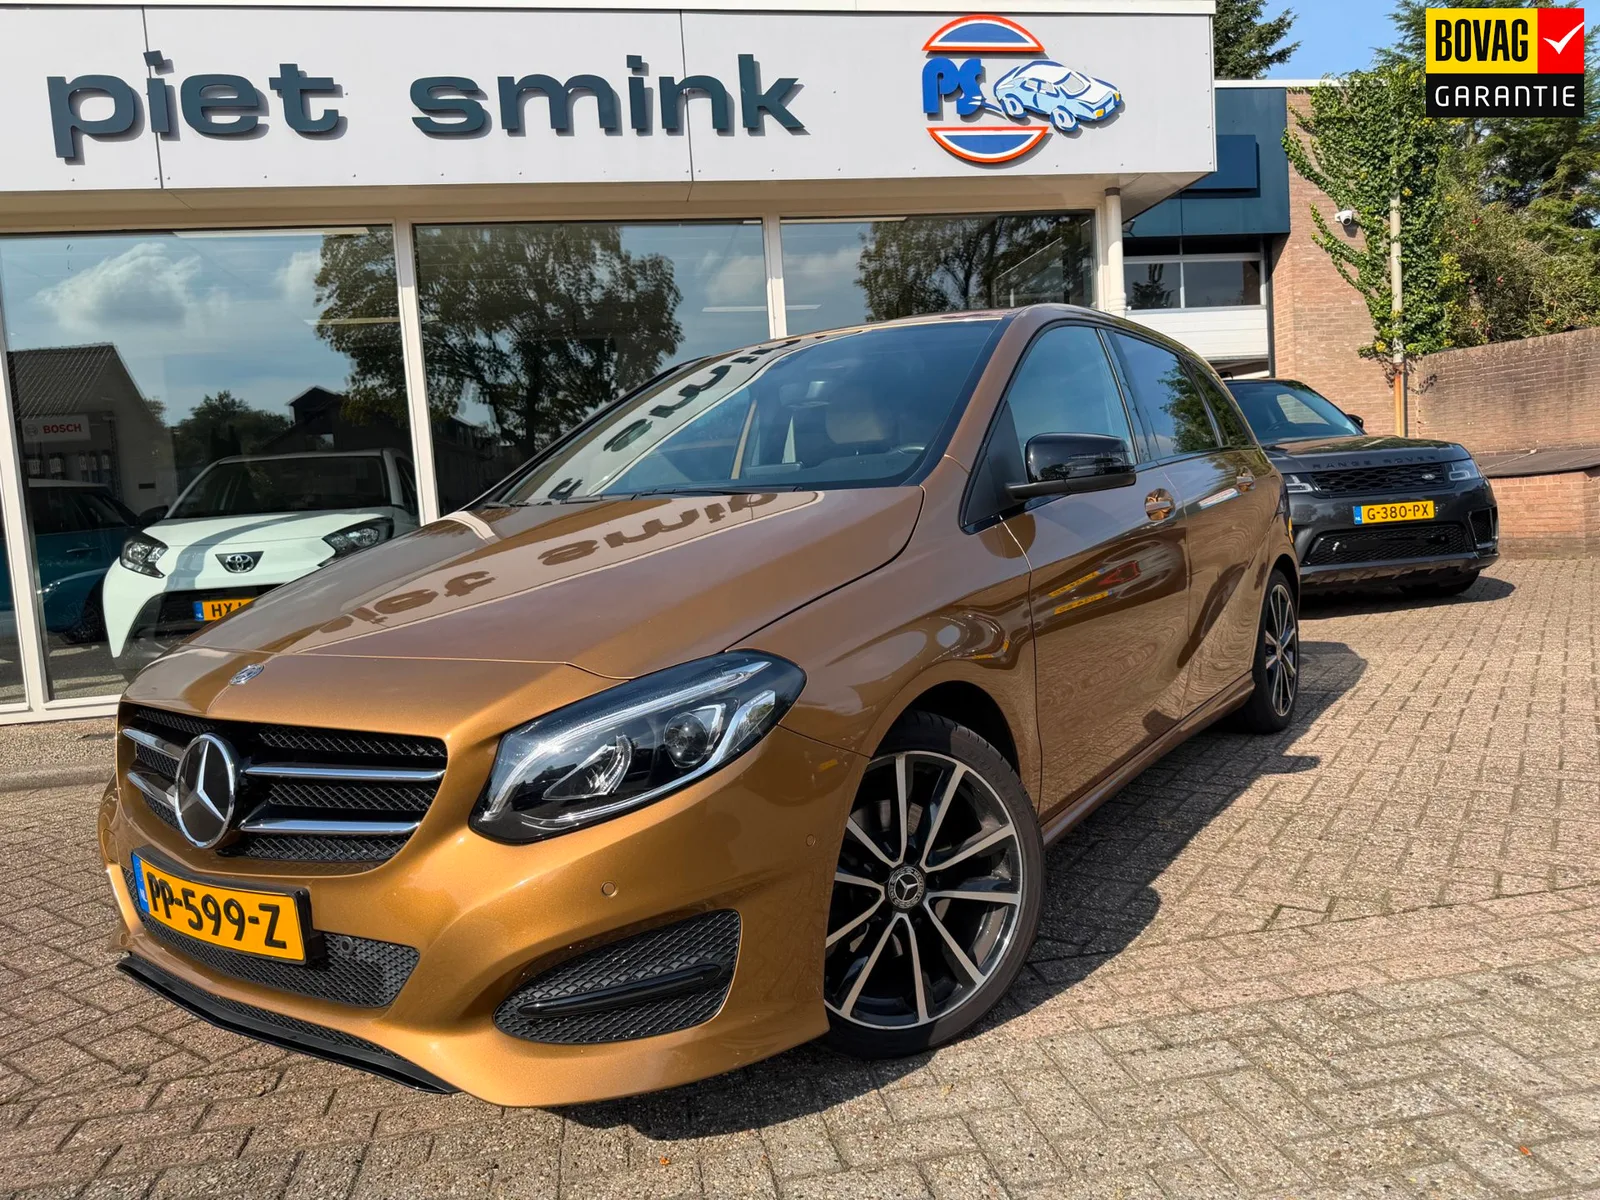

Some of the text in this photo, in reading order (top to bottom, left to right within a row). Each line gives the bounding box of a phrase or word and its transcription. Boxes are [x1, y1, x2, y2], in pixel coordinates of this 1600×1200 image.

[46, 50, 807, 160] piet smink
[42, 423, 82, 434] BOSCH
[1312, 455, 1436, 469] RANGE ROVER
[1367, 504, 1429, 520] G-380-PX
[146, 871, 287, 949] PP-599-Z
